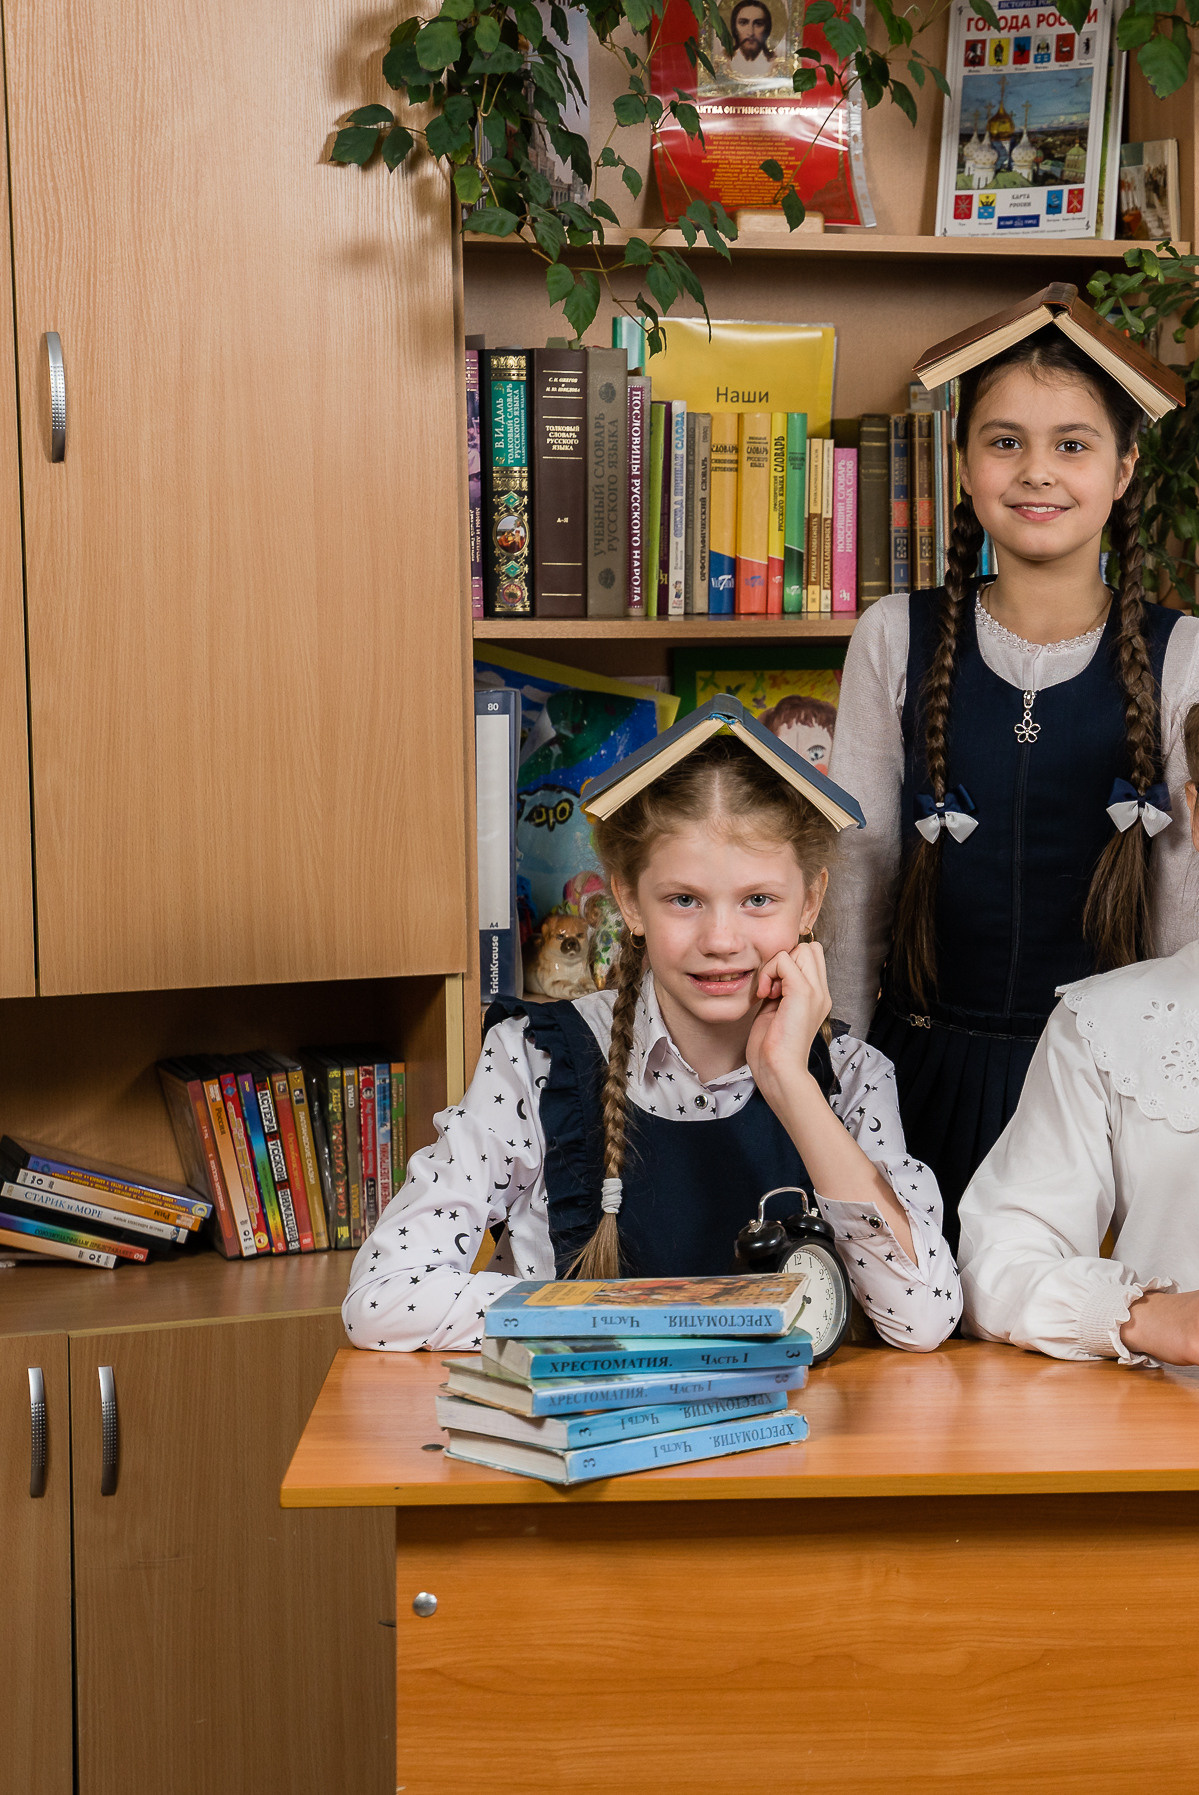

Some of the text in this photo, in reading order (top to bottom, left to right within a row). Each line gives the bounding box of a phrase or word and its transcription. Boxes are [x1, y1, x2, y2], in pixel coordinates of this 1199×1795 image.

[967, 8, 1098, 32] ГООДА РОСИ
[716, 387, 769, 403] Наши
[506, 383, 515, 464] ТОЛКОВЫЙ СЛОВАРЬ
[513, 417, 522, 459] РУССКОГО
[711, 444, 738, 453] СЛОВАРЬ
[746, 446, 768, 455] СЛОВАРЬ
[773, 435, 785, 473] СЛОВАРЬ
[593, 412, 605, 557] УЧЕБНЫЙ СЛОВАРЬ
[607, 418, 619, 552] РУССКОГО ЯЗЫКА
[673, 411, 686, 538] ОТКУДА ПРИШЛИ СЛОВА
[631, 390, 642, 602] ПОСЛОВИЦЫ РУССКОГО НАРОДА
[837, 459, 846, 552] НОВЕЙШИЙ СЛОВАРЬ
[845, 460, 854, 553] ИНОСТРАННЫХ СЛОВ
[699, 457, 708, 582] ОРФОГРАФИЧЕСКИЙ СЛОВАРЬ
[487, 703, 499, 711] 80
[490, 935, 499, 995] ErichKrause
[215, 1107, 226, 1136] Россия
[24, 1191, 66, 1209] СТАРИК
[75, 1205, 103, 1218] МОРЕ
[794, 1253, 802, 1266] 12
[819, 1268, 824, 1281] 2
[825, 1289, 831, 1300] 3
[504, 1318, 519, 1328] 3
[664, 1315, 772, 1328] ХРЕСТОМАТИЯ.
[823, 1309, 828, 1320] 4
[816, 1327, 821, 1339] 5
[550, 1356, 672, 1374] ХРЕСТОМАТИЯ.
[786, 1350, 800, 1358] 3
[548, 1386, 648, 1407] ХРЕСТОМАТИЯ.
[679, 1392, 773, 1419] ХРЕСТОМАТИЯ.
[579, 1427, 592, 1437] 3
[709, 1422, 794, 1448] ХРЕСТОМАТИЯ.
[583, 1457, 596, 1468] 3
